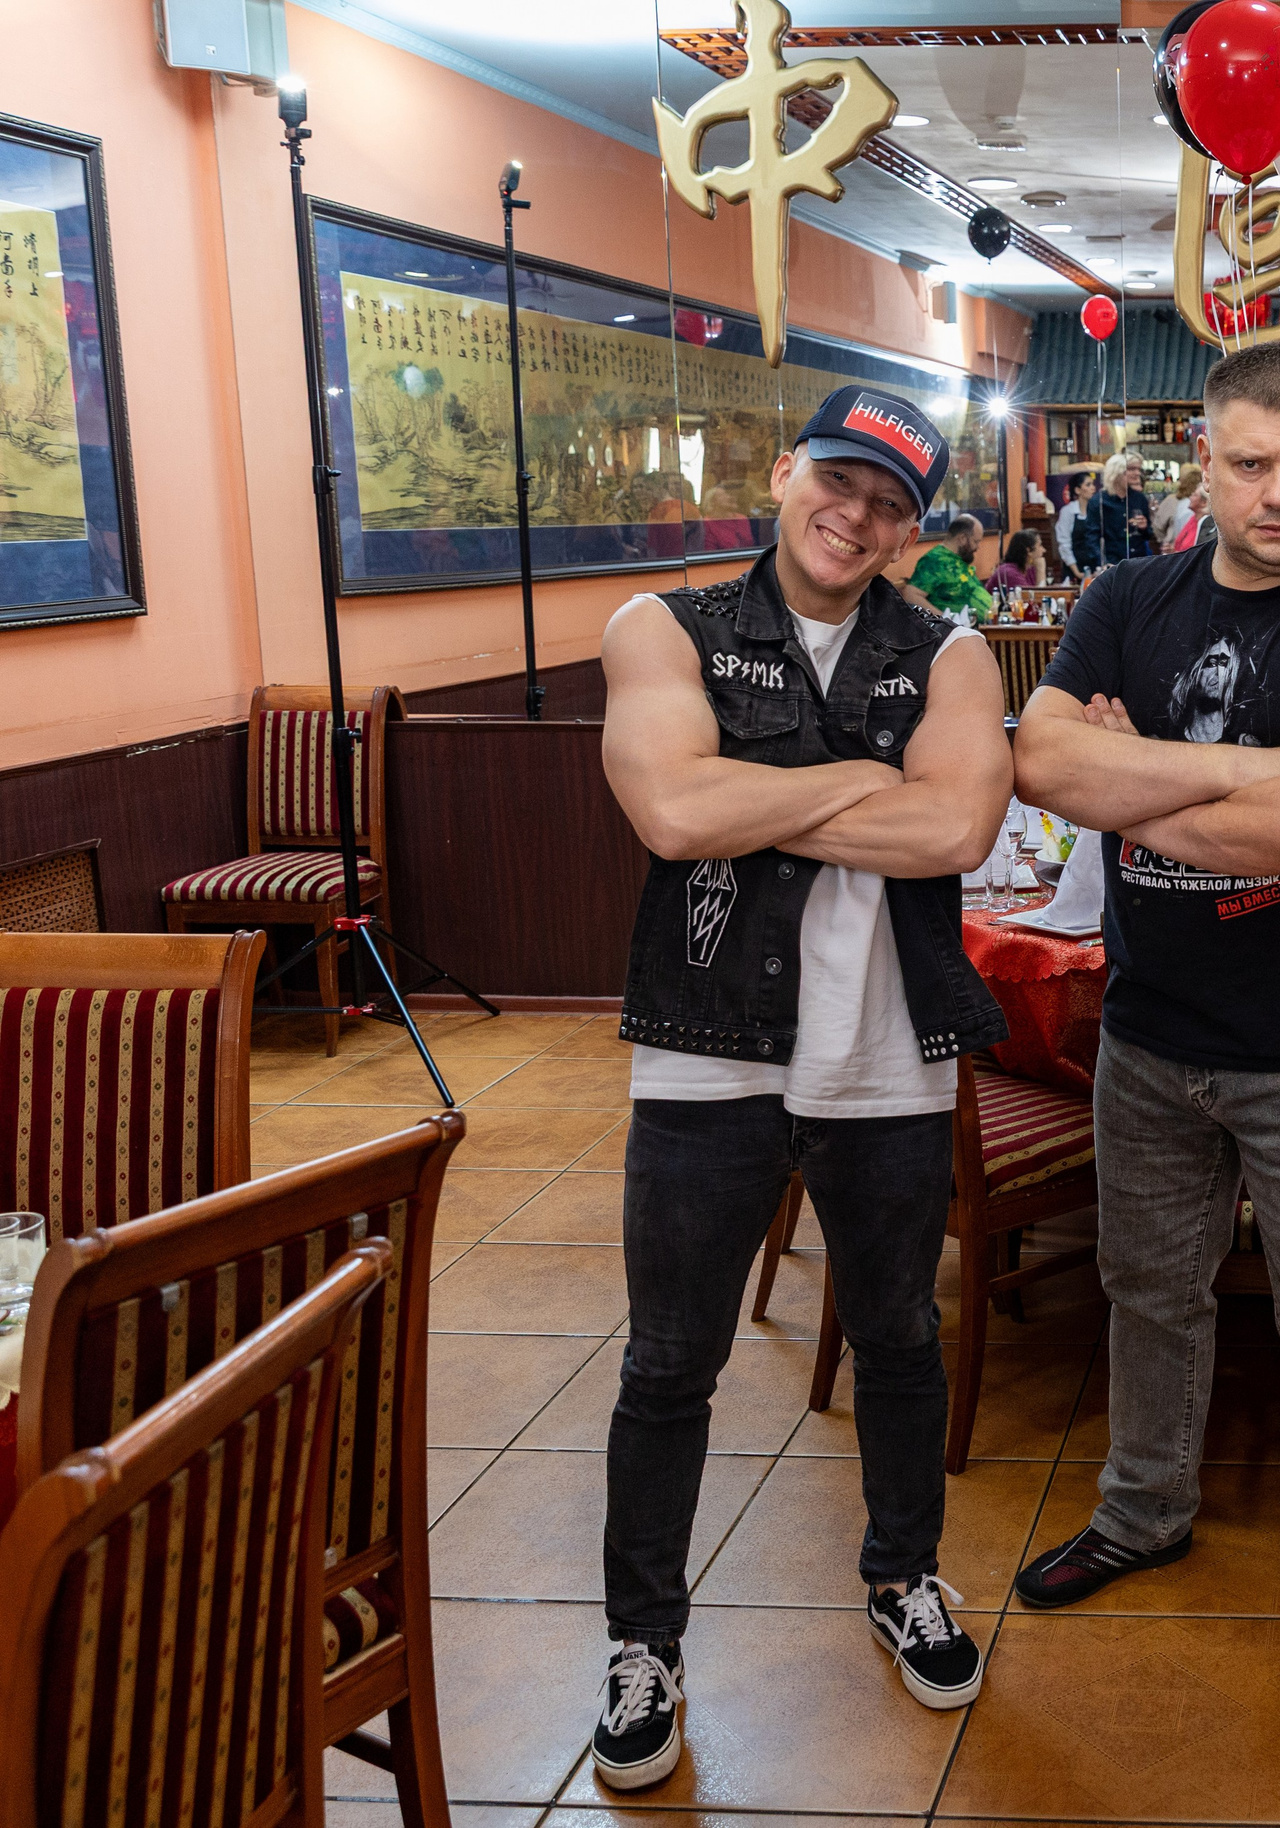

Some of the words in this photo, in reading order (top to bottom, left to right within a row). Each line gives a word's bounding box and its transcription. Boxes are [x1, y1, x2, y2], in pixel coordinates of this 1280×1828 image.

[854, 402, 934, 461] HILFIGER
[693, 858, 732, 892] CLUB
[1121, 869, 1172, 890] ФЕСТИВАЛЬ
[1173, 877, 1232, 891] ТЯЖЕЛОЙ
[1217, 899, 1242, 916] МЫ
